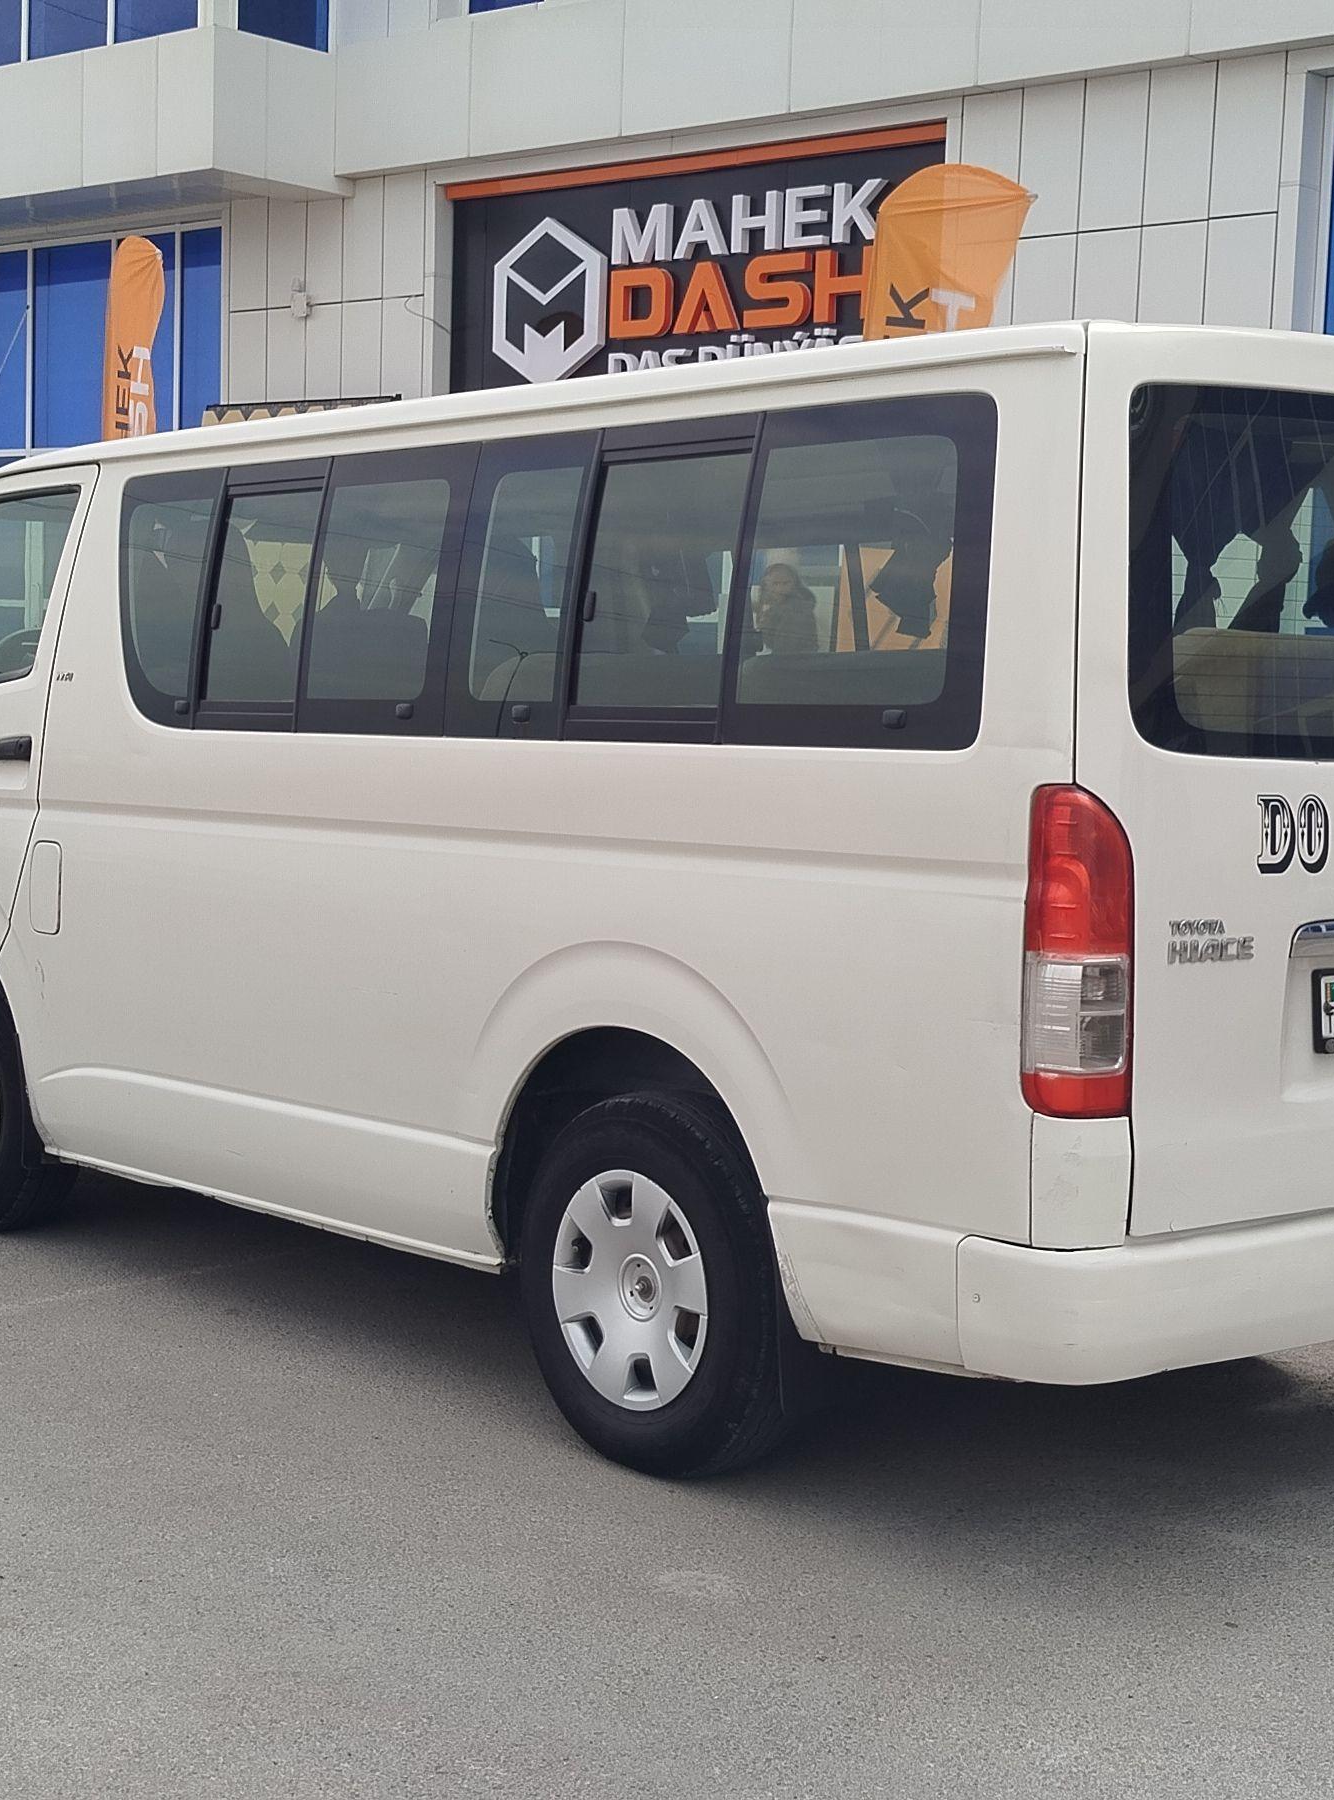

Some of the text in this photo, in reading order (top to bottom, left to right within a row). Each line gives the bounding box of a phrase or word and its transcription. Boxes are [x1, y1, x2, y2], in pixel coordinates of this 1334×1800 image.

[610, 178, 889, 266] MAHEK
[609, 244, 873, 340] DASH
[1167, 936, 1255, 965] HIACE
[1168, 919, 1226, 937] TOYOTA
